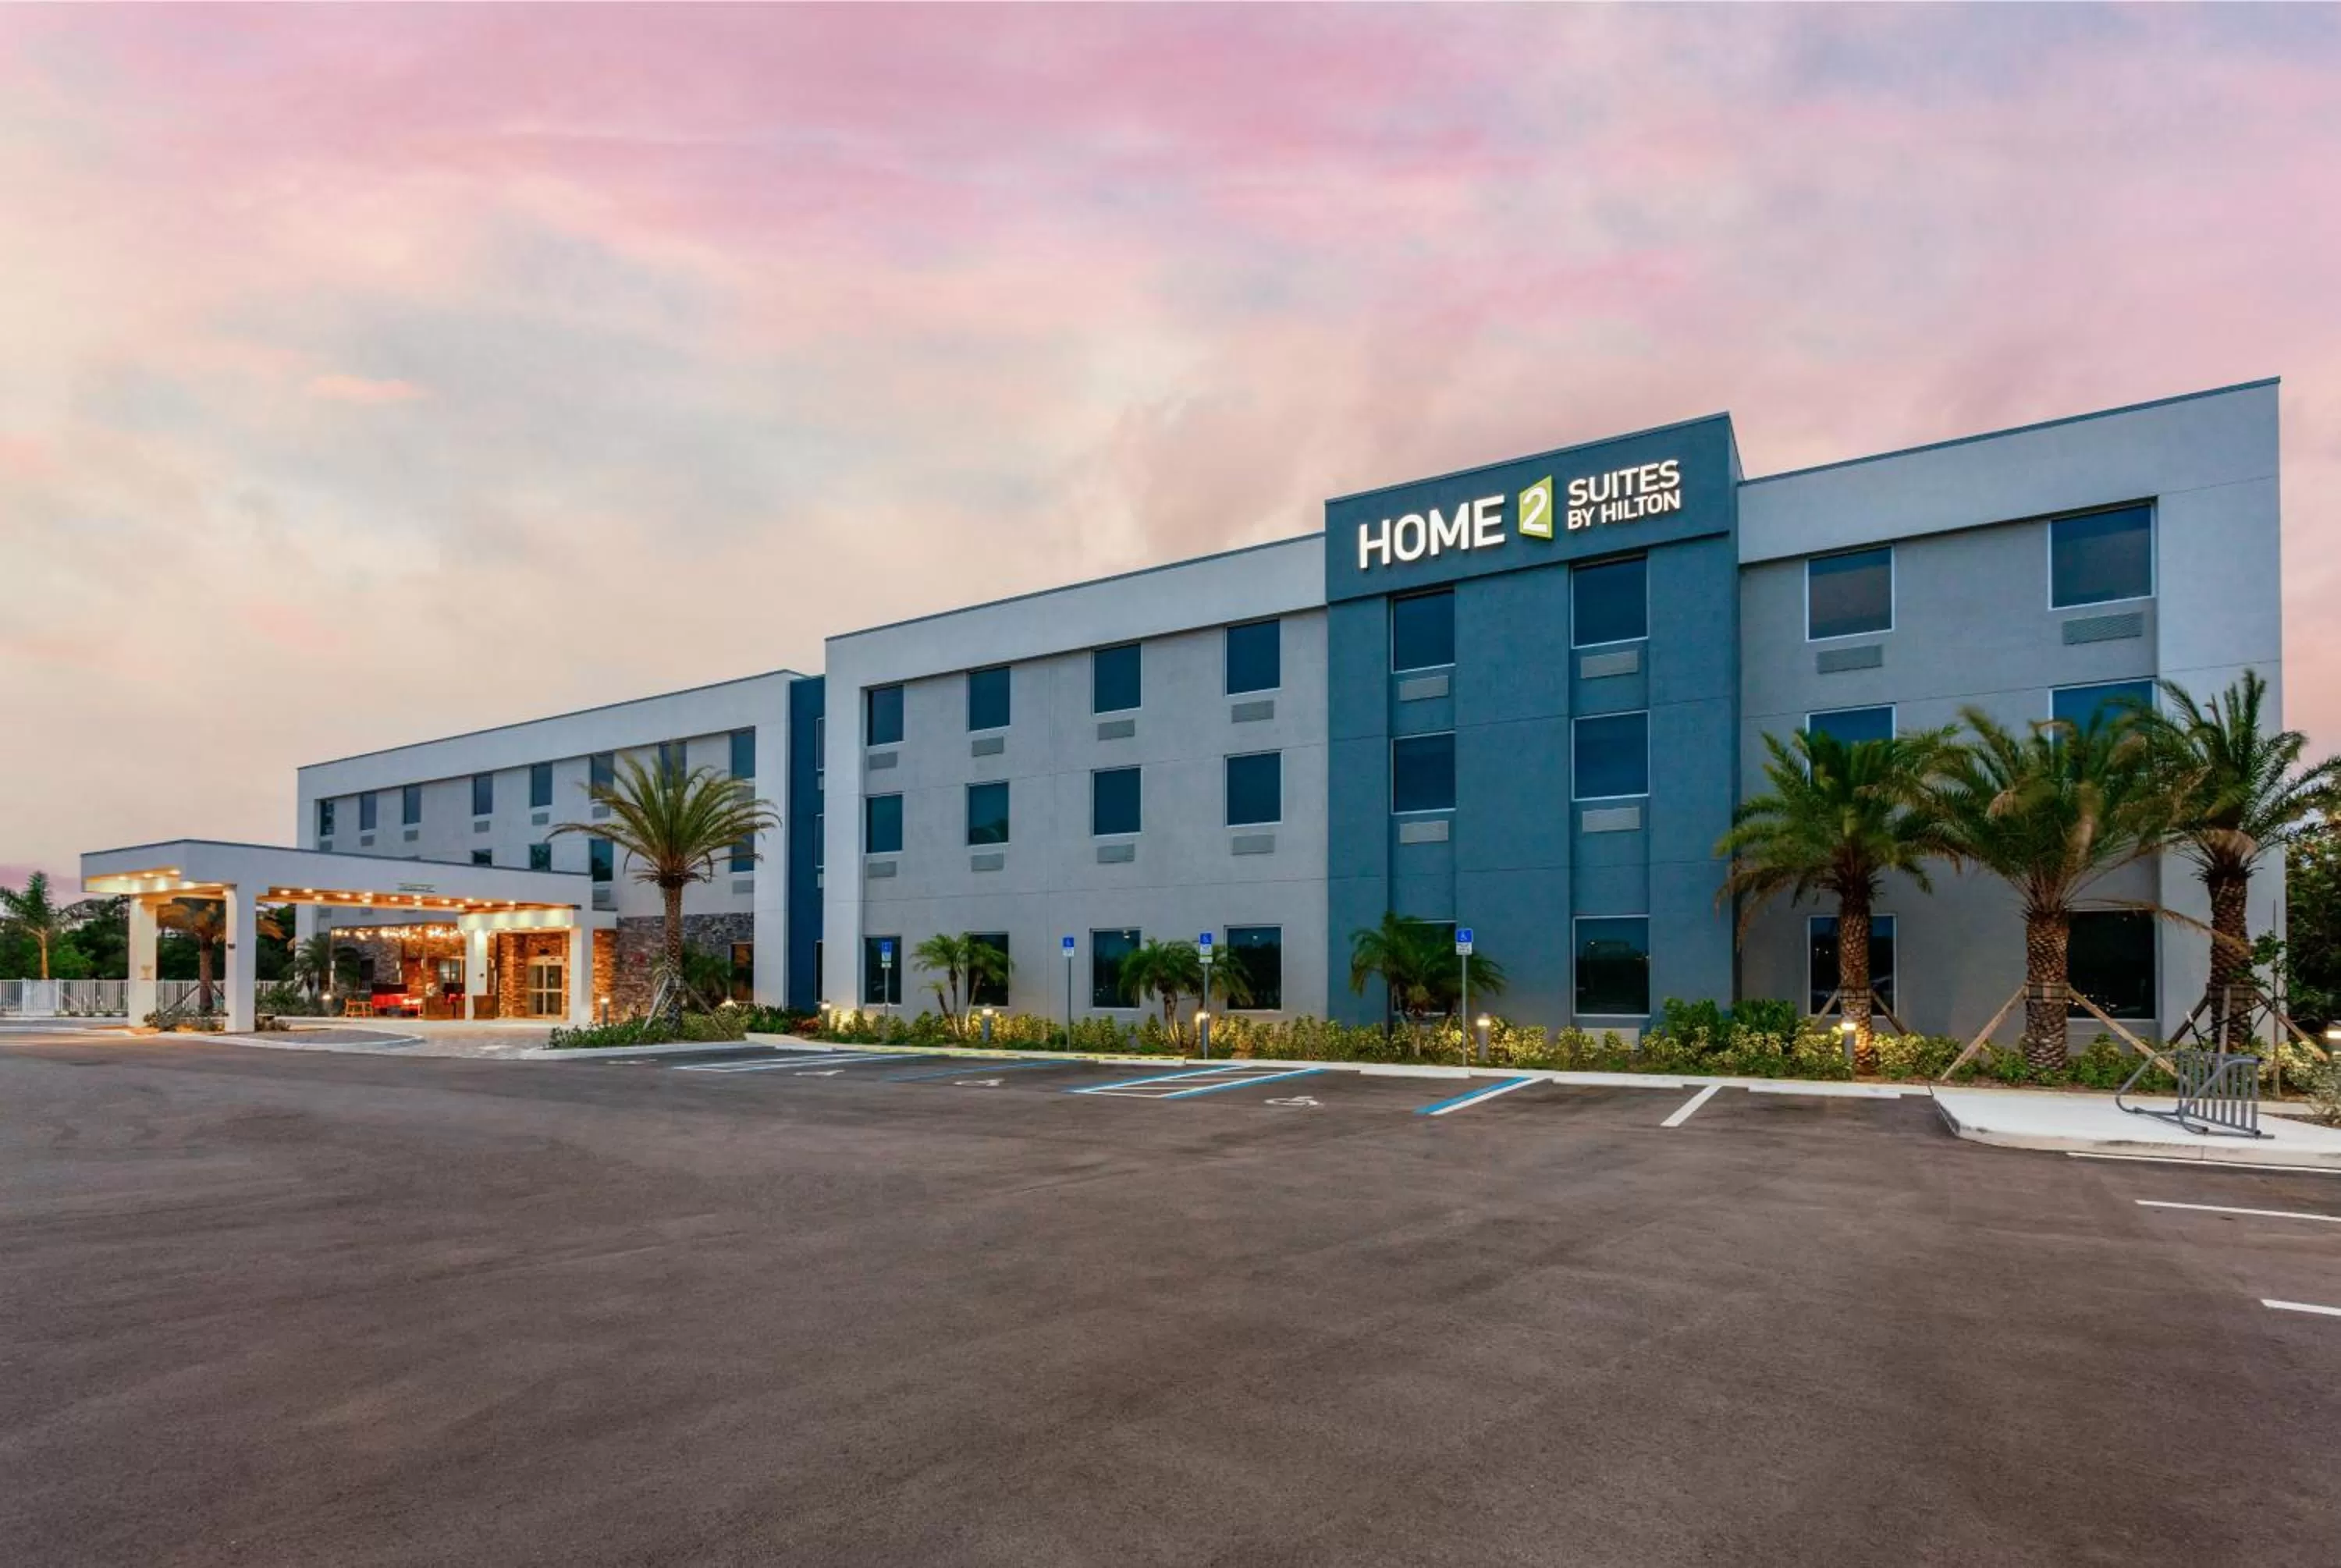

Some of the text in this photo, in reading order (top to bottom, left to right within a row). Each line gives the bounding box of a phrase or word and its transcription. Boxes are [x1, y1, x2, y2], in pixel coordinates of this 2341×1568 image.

[1568, 459, 1681, 506] SUITES
[1359, 487, 1549, 569] HOME 2
[1568, 488, 1681, 530] BY HILTON
